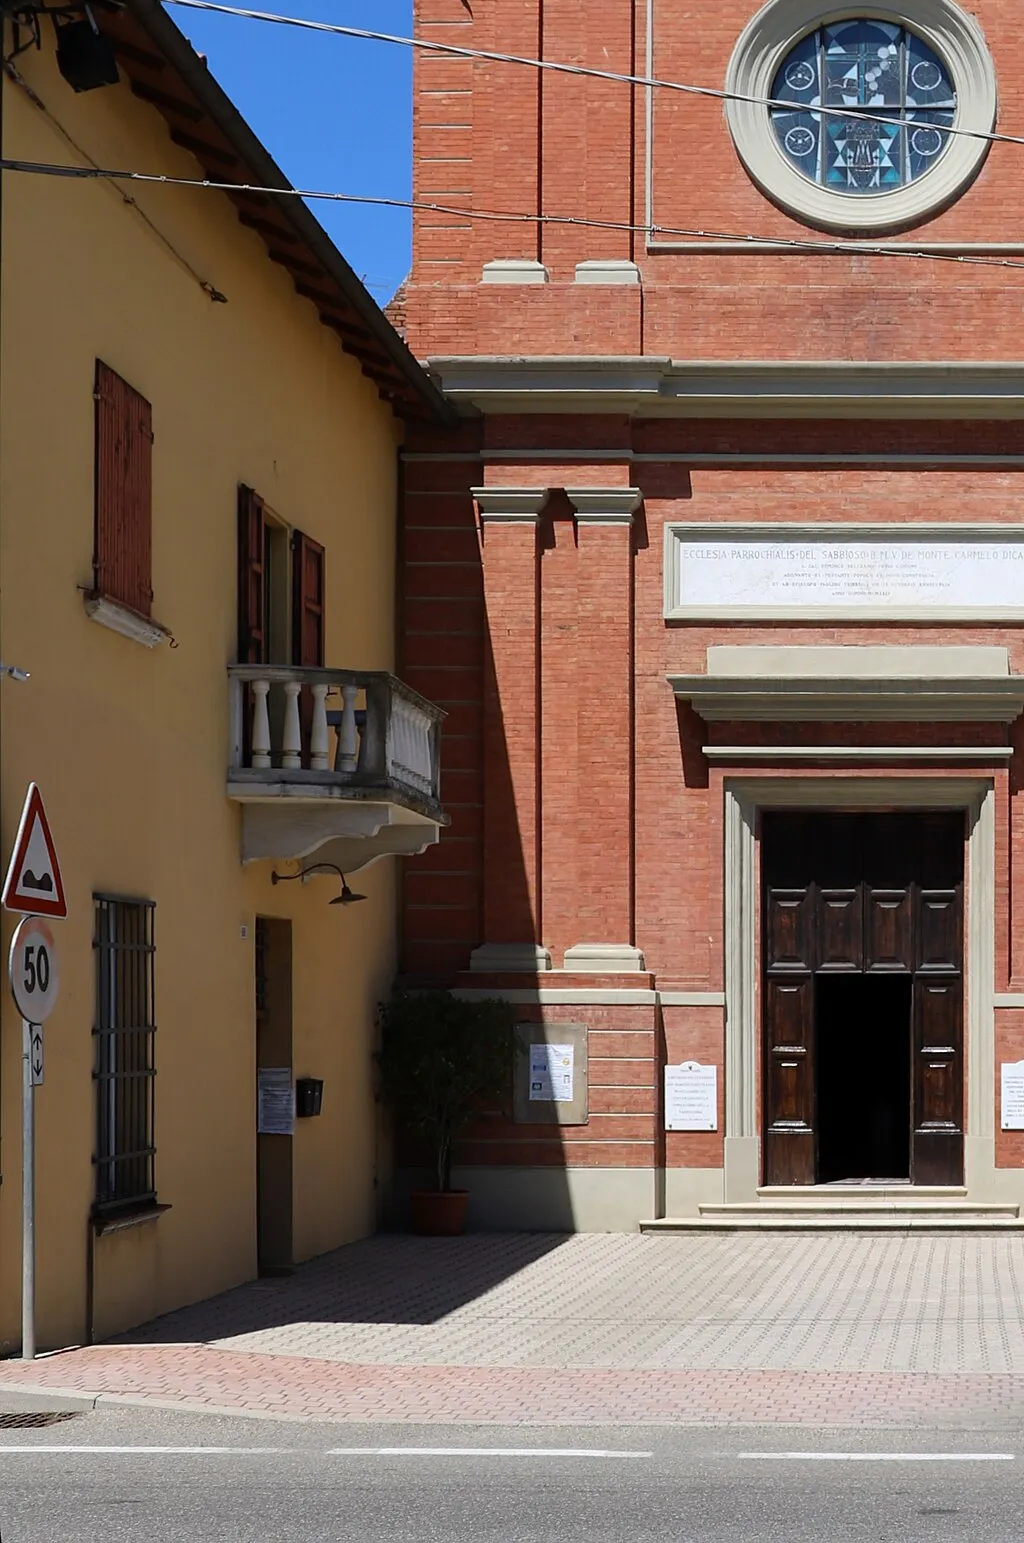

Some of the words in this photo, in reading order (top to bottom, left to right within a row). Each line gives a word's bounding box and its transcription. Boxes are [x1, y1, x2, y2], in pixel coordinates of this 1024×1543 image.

[684, 549, 727, 560] ECCLESIA
[799, 549, 816, 560] DEL
[917, 549, 950, 560] MONTE
[954, 549, 999, 560] CARMELO
[24, 945, 49, 994] 50
